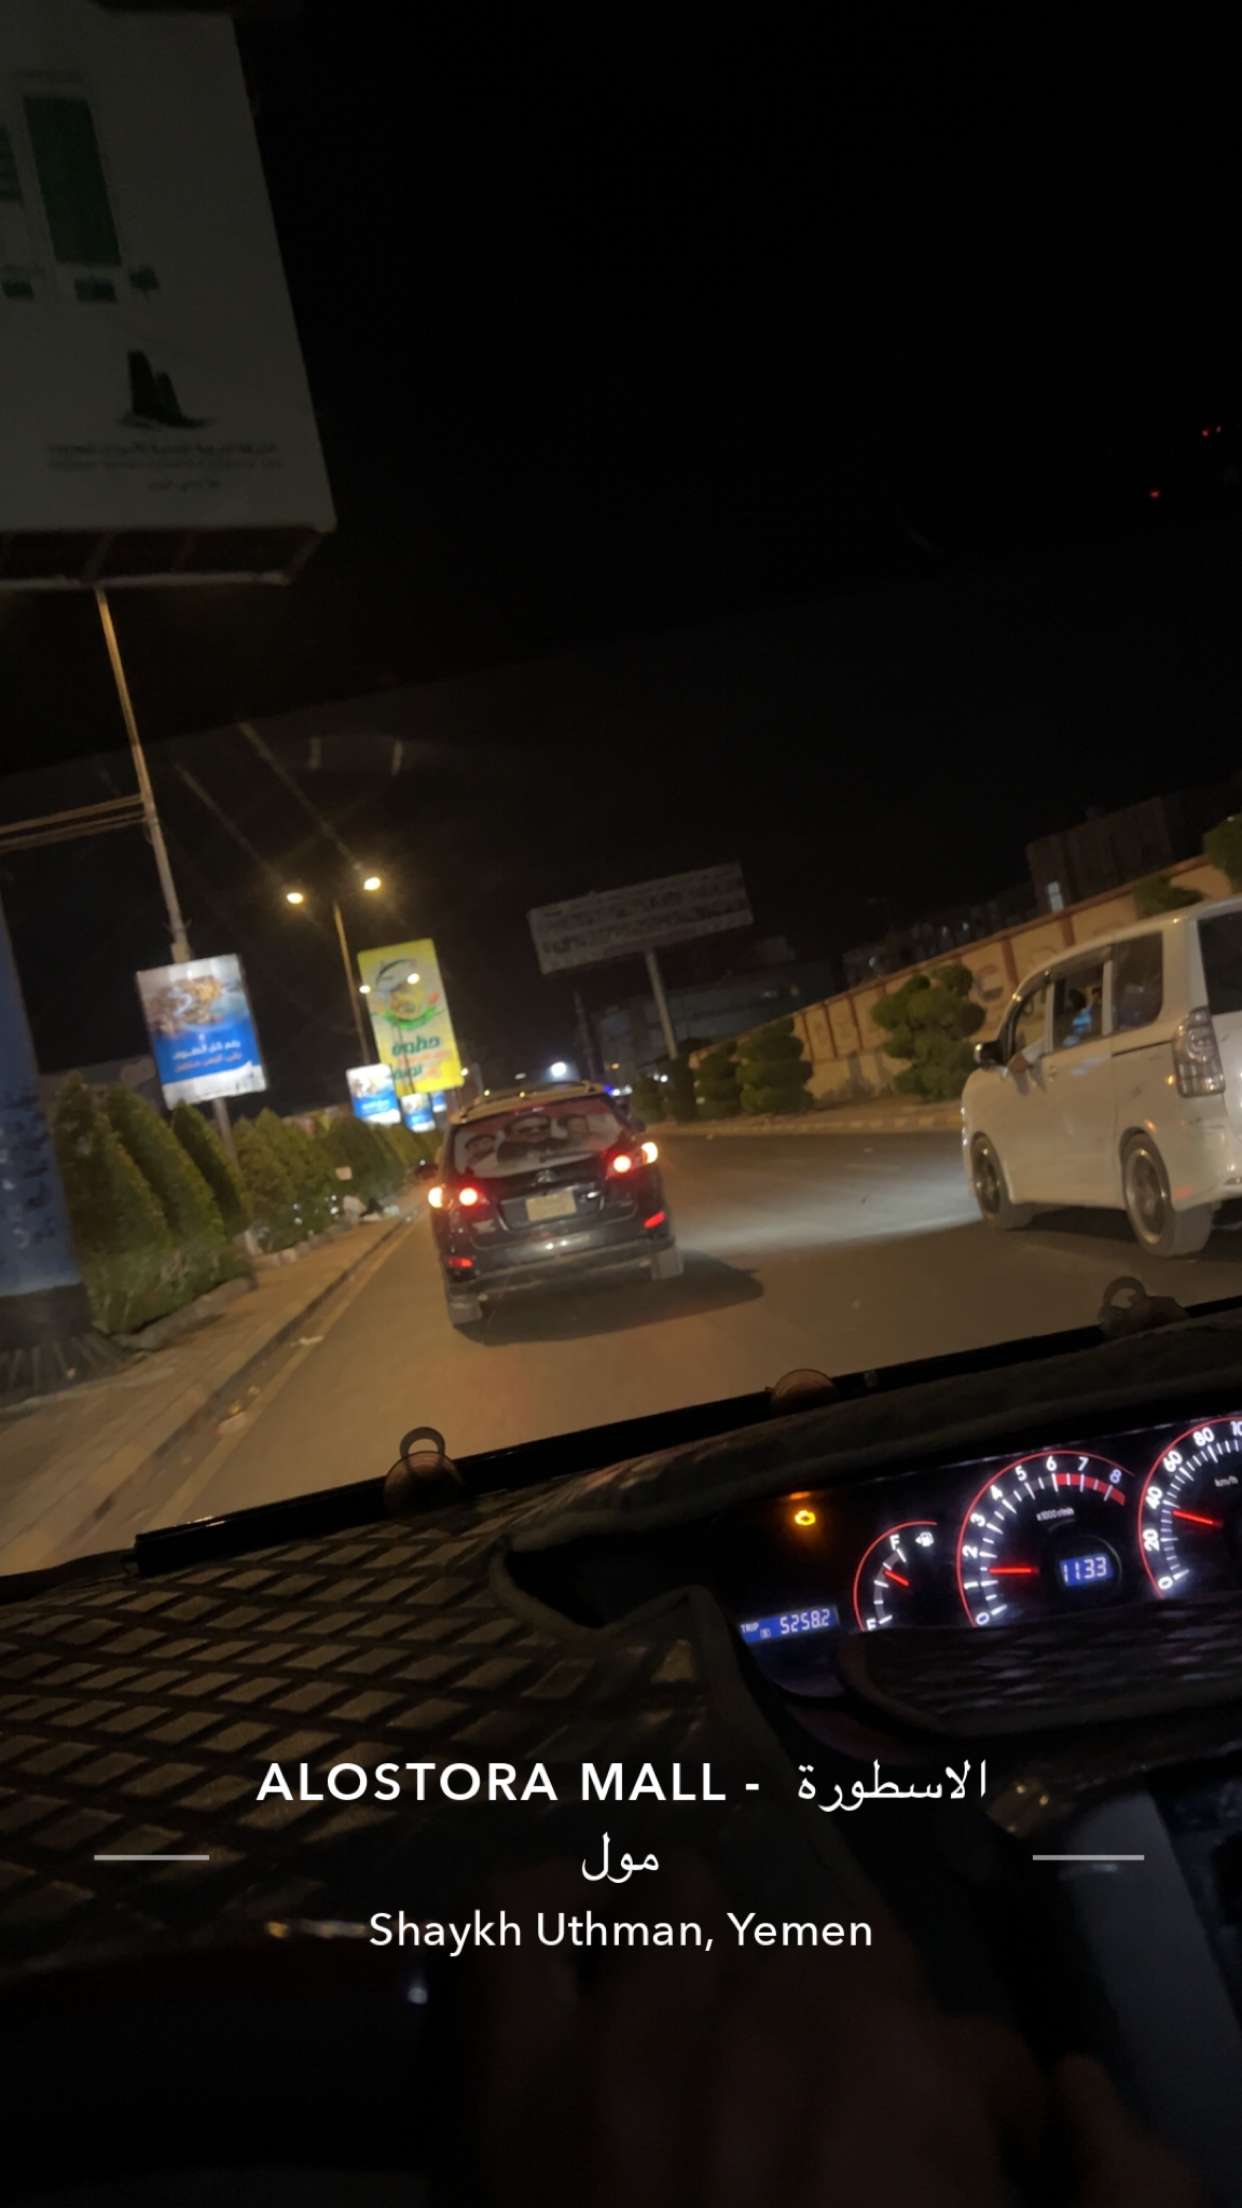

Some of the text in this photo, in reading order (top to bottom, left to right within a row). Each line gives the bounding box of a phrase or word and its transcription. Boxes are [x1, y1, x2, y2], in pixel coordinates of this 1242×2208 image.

[1193, 1428, 1214, 1447] 80
[1046, 1456, 1057, 1471] 6
[1078, 1457, 1089, 1471] 7
[1163, 1450, 1182, 1473] 60
[1014, 1466, 1027, 1481] 5
[1109, 1469, 1122, 1483] 8
[990, 1485, 1003, 1500] 4
[1146, 1486, 1162, 1510] 40
[970, 1513, 985, 1527] 3
[889, 1534, 899, 1550] F
[1143, 1529, 1160, 1551] 20
[962, 1545, 978, 1559] 2
[1158, 1576, 1173, 1590] 0
[976, 1612, 989, 1625] 0
[740, 1622, 759, 1632] TRIP
